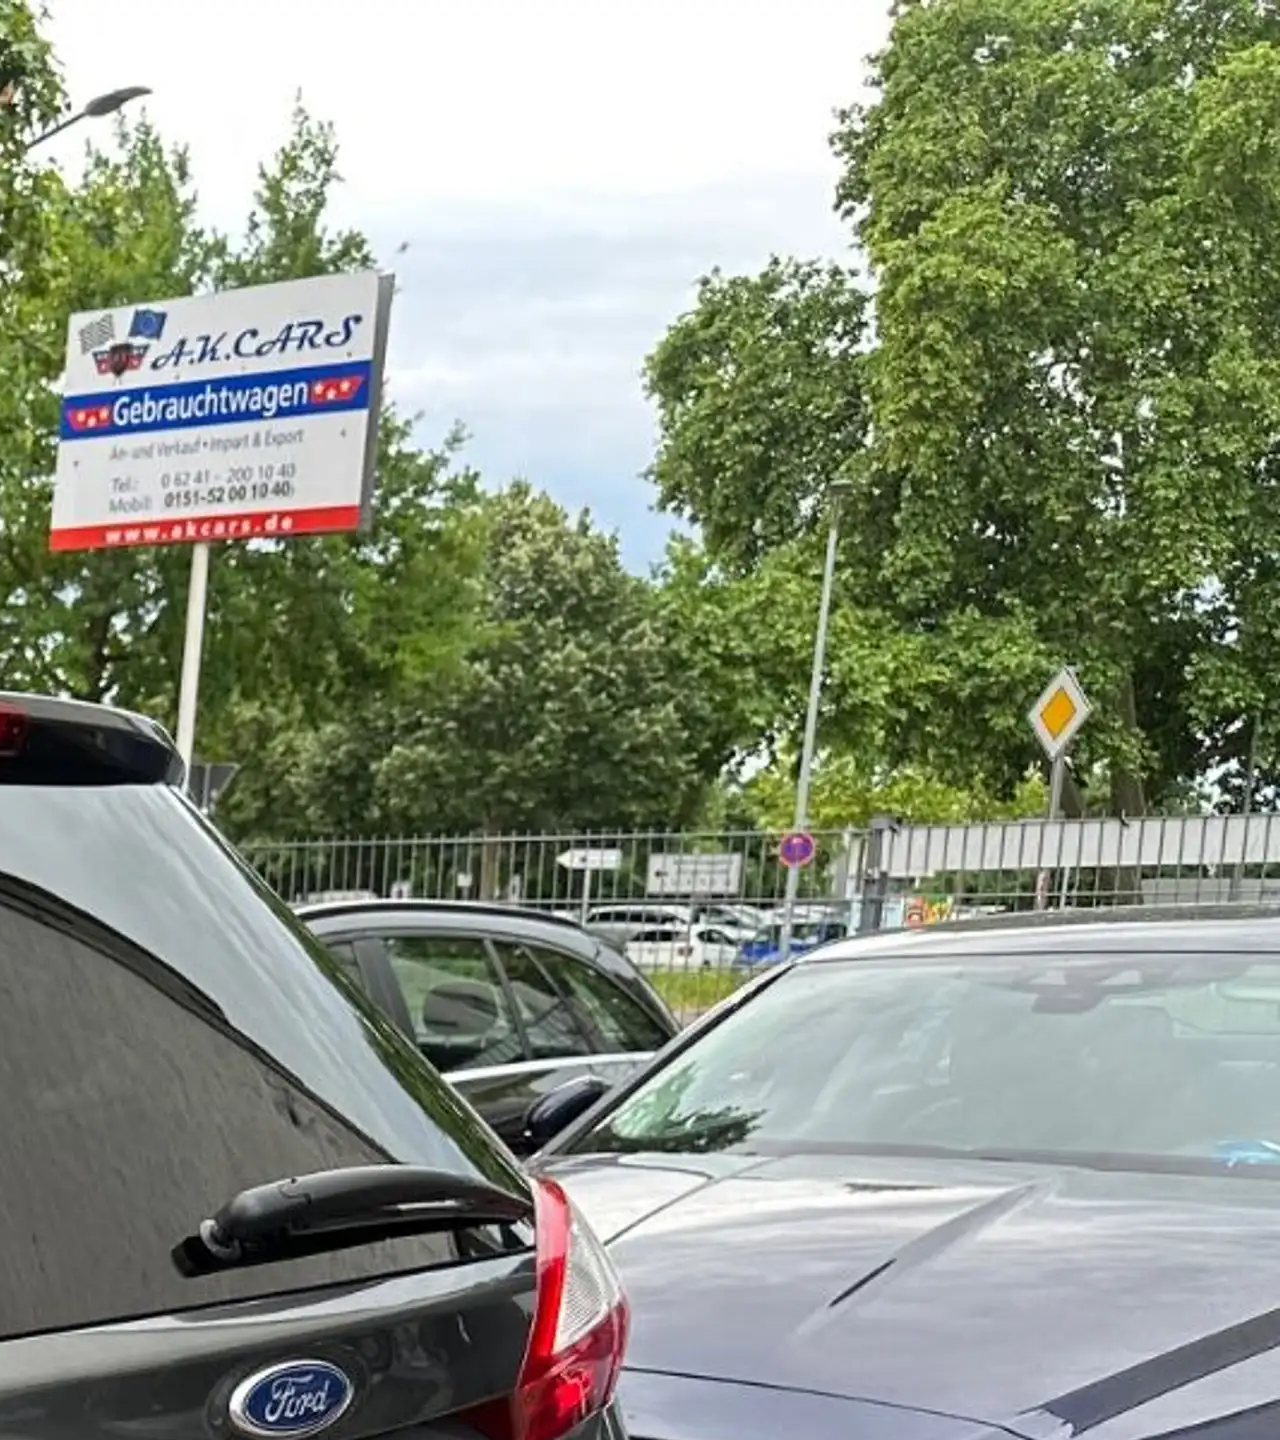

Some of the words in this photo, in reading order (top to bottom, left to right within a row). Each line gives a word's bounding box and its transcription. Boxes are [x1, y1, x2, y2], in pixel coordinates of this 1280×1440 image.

[113, 381, 308, 426] Gebrauchtwagen
[265, 429, 304, 448] Export
[105, 514, 292, 543] www.akcars.de
[265, 1374, 330, 1422] Ford
